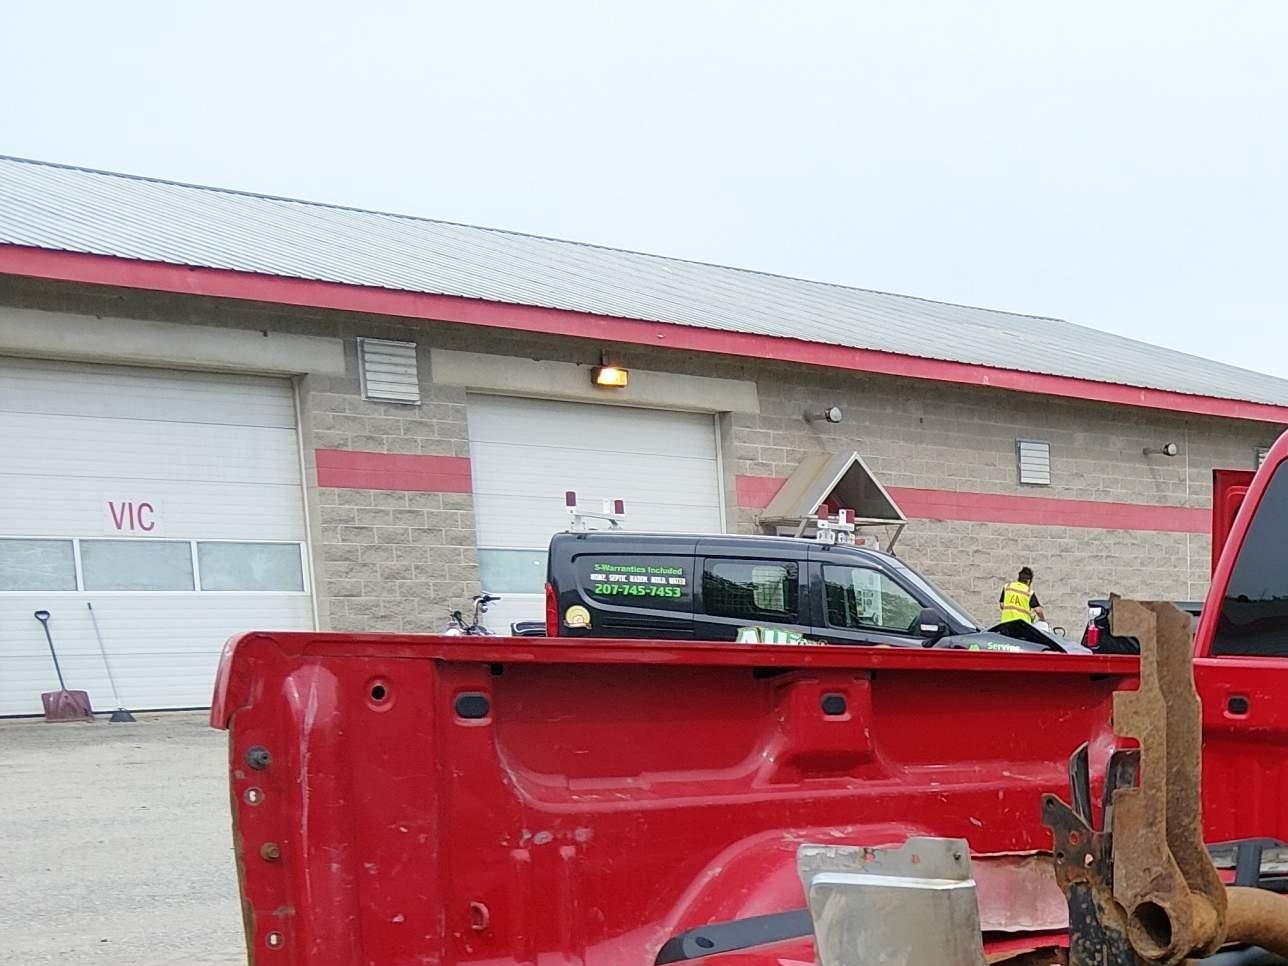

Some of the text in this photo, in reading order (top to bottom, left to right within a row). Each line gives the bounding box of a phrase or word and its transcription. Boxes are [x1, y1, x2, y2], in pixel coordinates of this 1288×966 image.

[107, 501, 155, 532] VIC
[648, 566, 683, 575] Included
[594, 583, 681, 598] 207-745-7453
